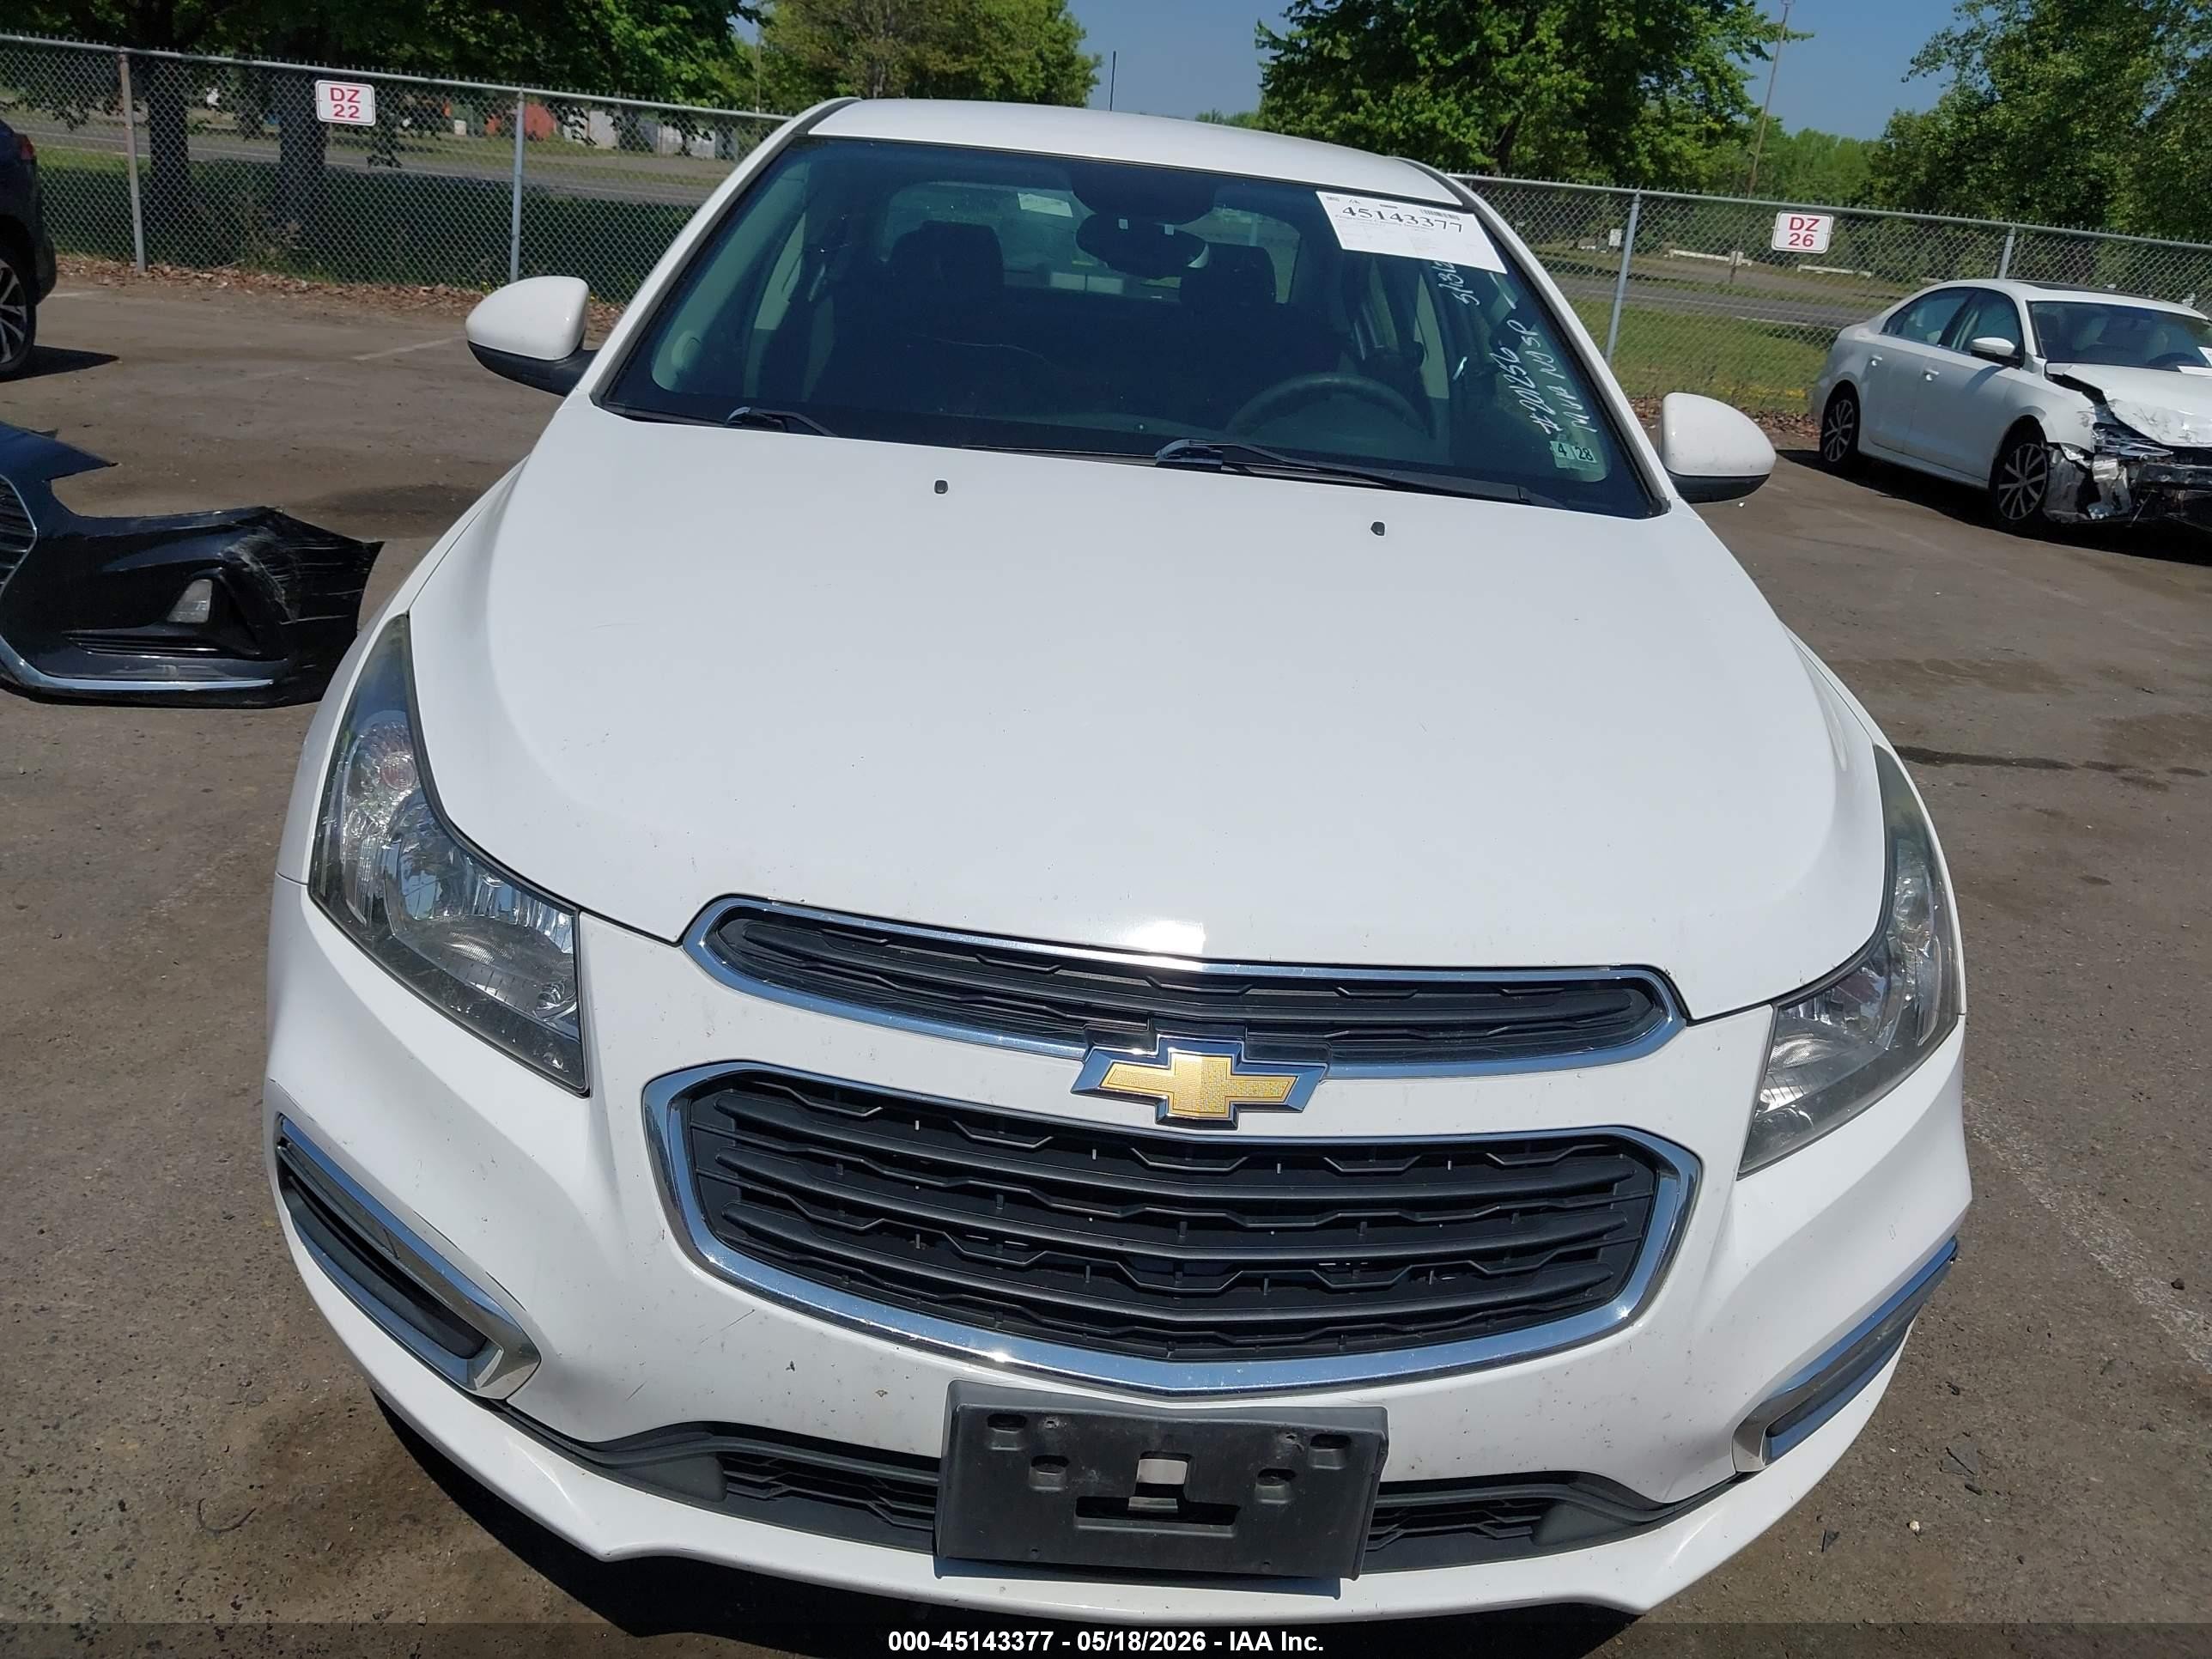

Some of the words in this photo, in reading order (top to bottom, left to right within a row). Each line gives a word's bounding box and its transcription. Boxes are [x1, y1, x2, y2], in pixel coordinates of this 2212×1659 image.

[329, 87, 362, 103] DZ
[333, 103, 361, 119] 22
[1341, 205, 1463, 234] 45143377
[1789, 216, 1820, 232] DZ
[1788, 232, 1814, 247] 26
[1431, 260, 1480, 306] 5/13/2
[1557, 442, 1567, 457] 4
[1574, 446, 1594, 462] 28
